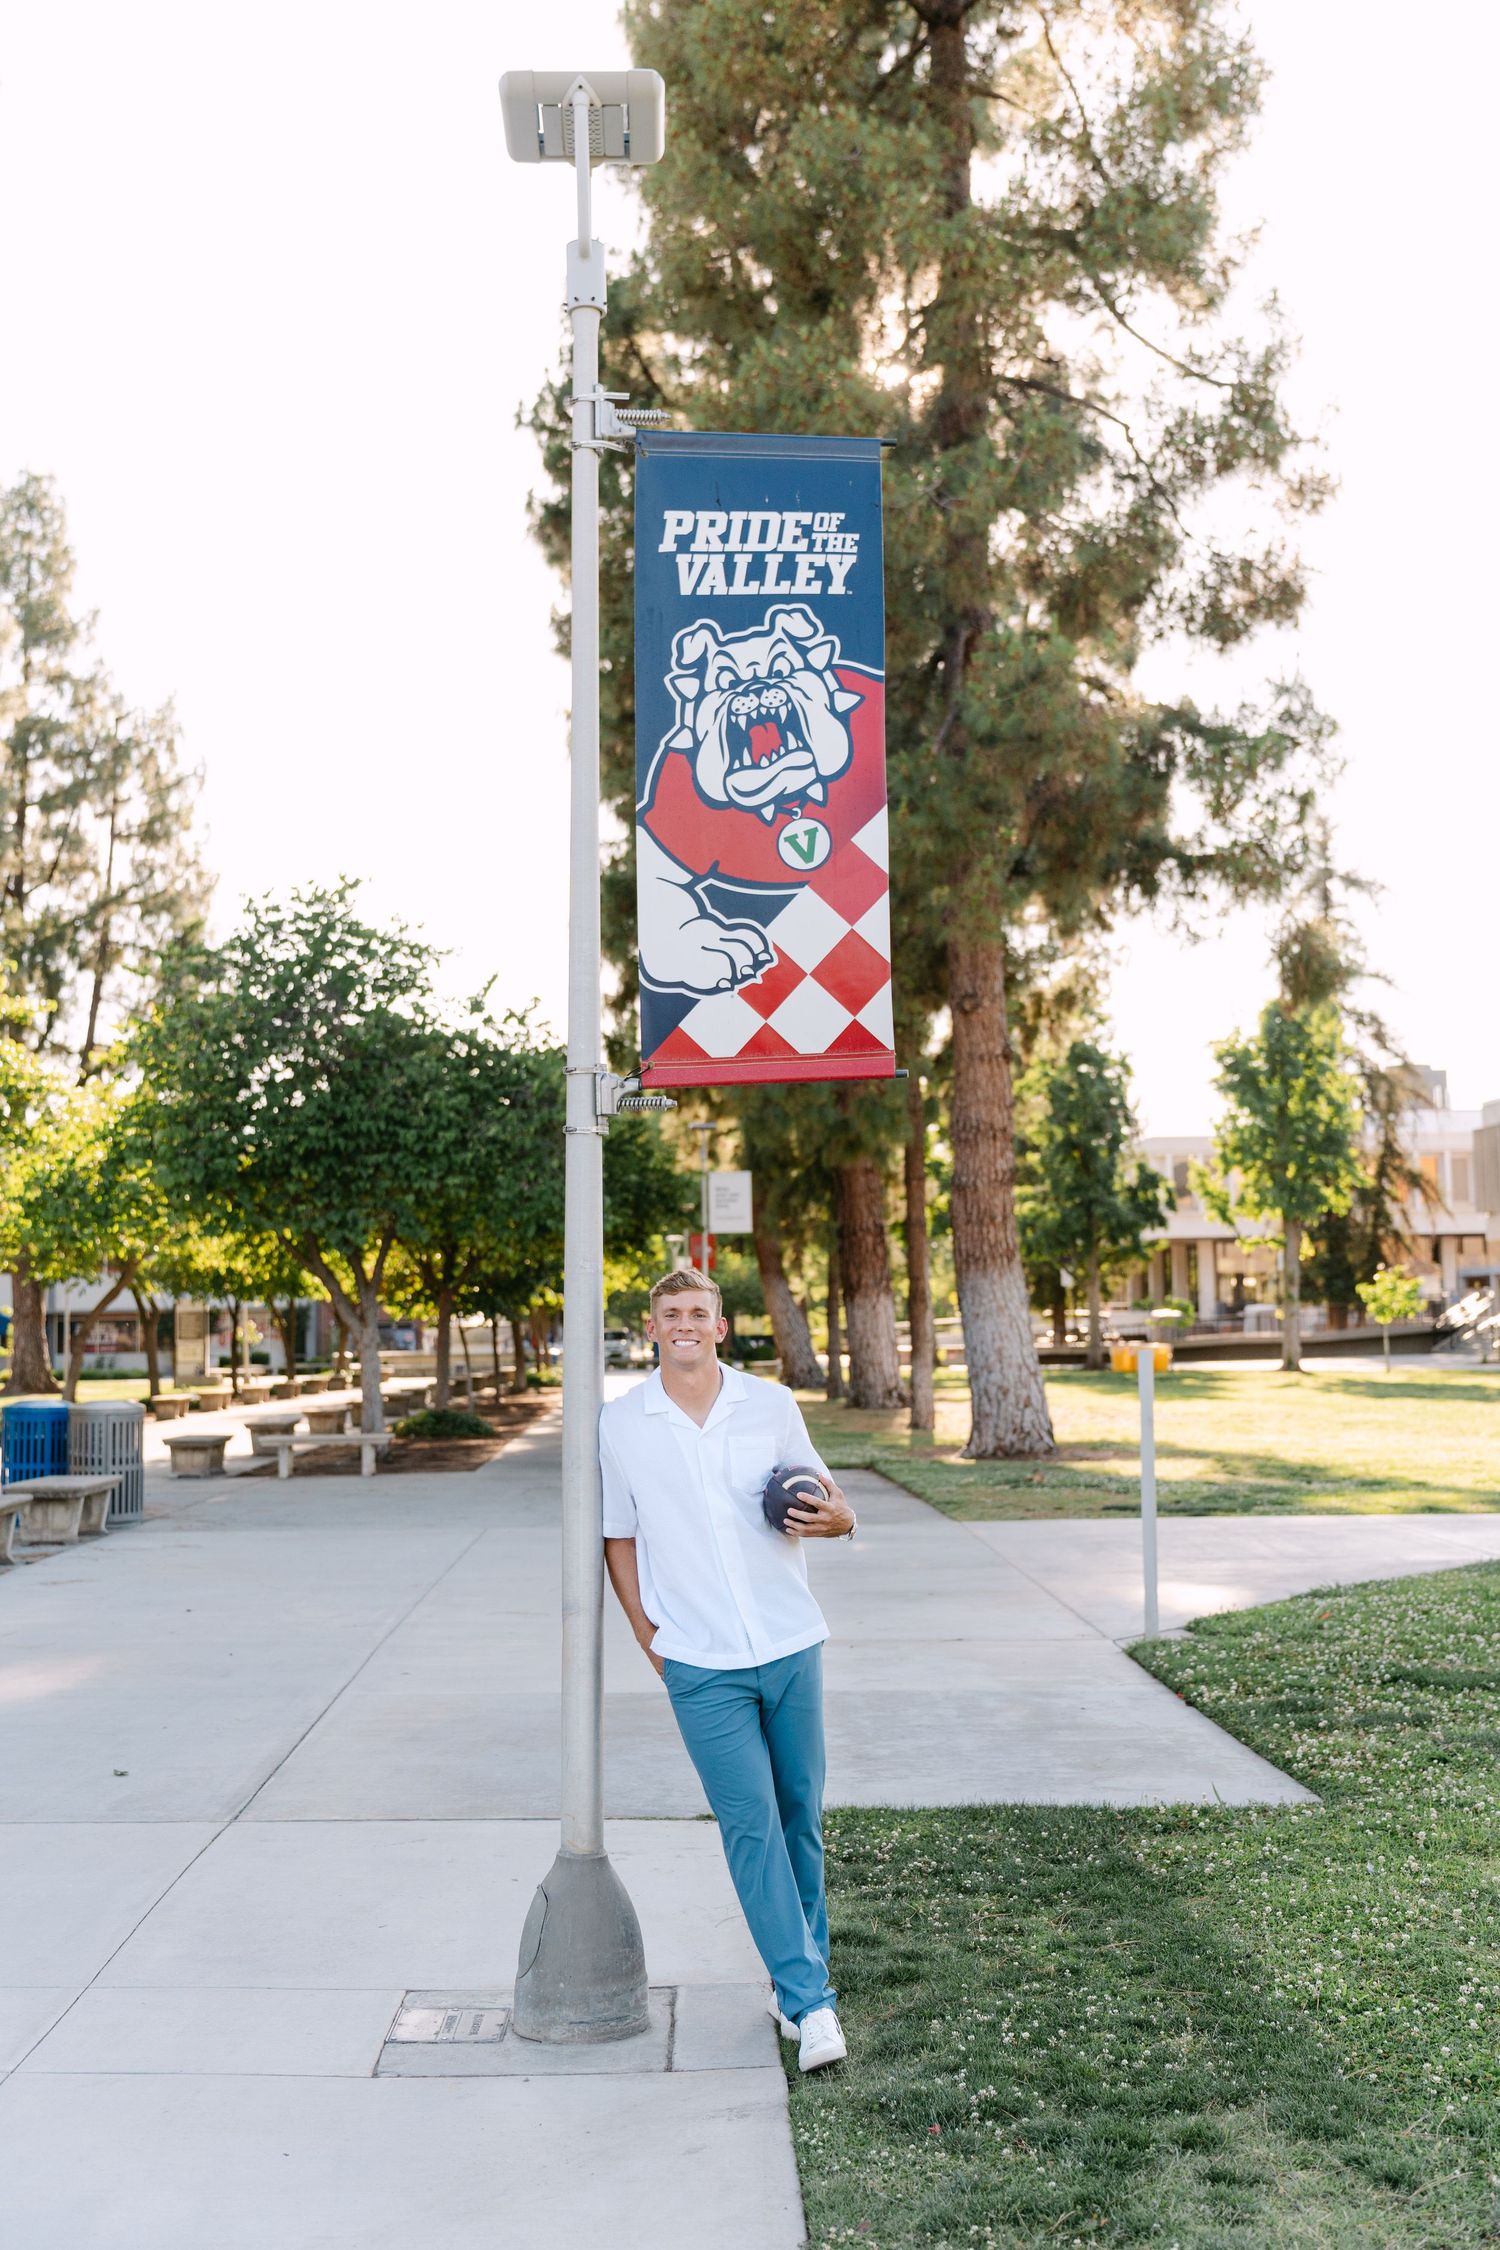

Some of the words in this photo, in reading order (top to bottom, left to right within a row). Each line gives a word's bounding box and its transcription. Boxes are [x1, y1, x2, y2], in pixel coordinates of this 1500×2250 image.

[658, 510, 813, 553] PRIDE
[813, 512, 846, 532] OF
[812, 533, 860, 553] THE
[675, 553, 858, 595] VALLEY
[784, 827, 819, 864] V
